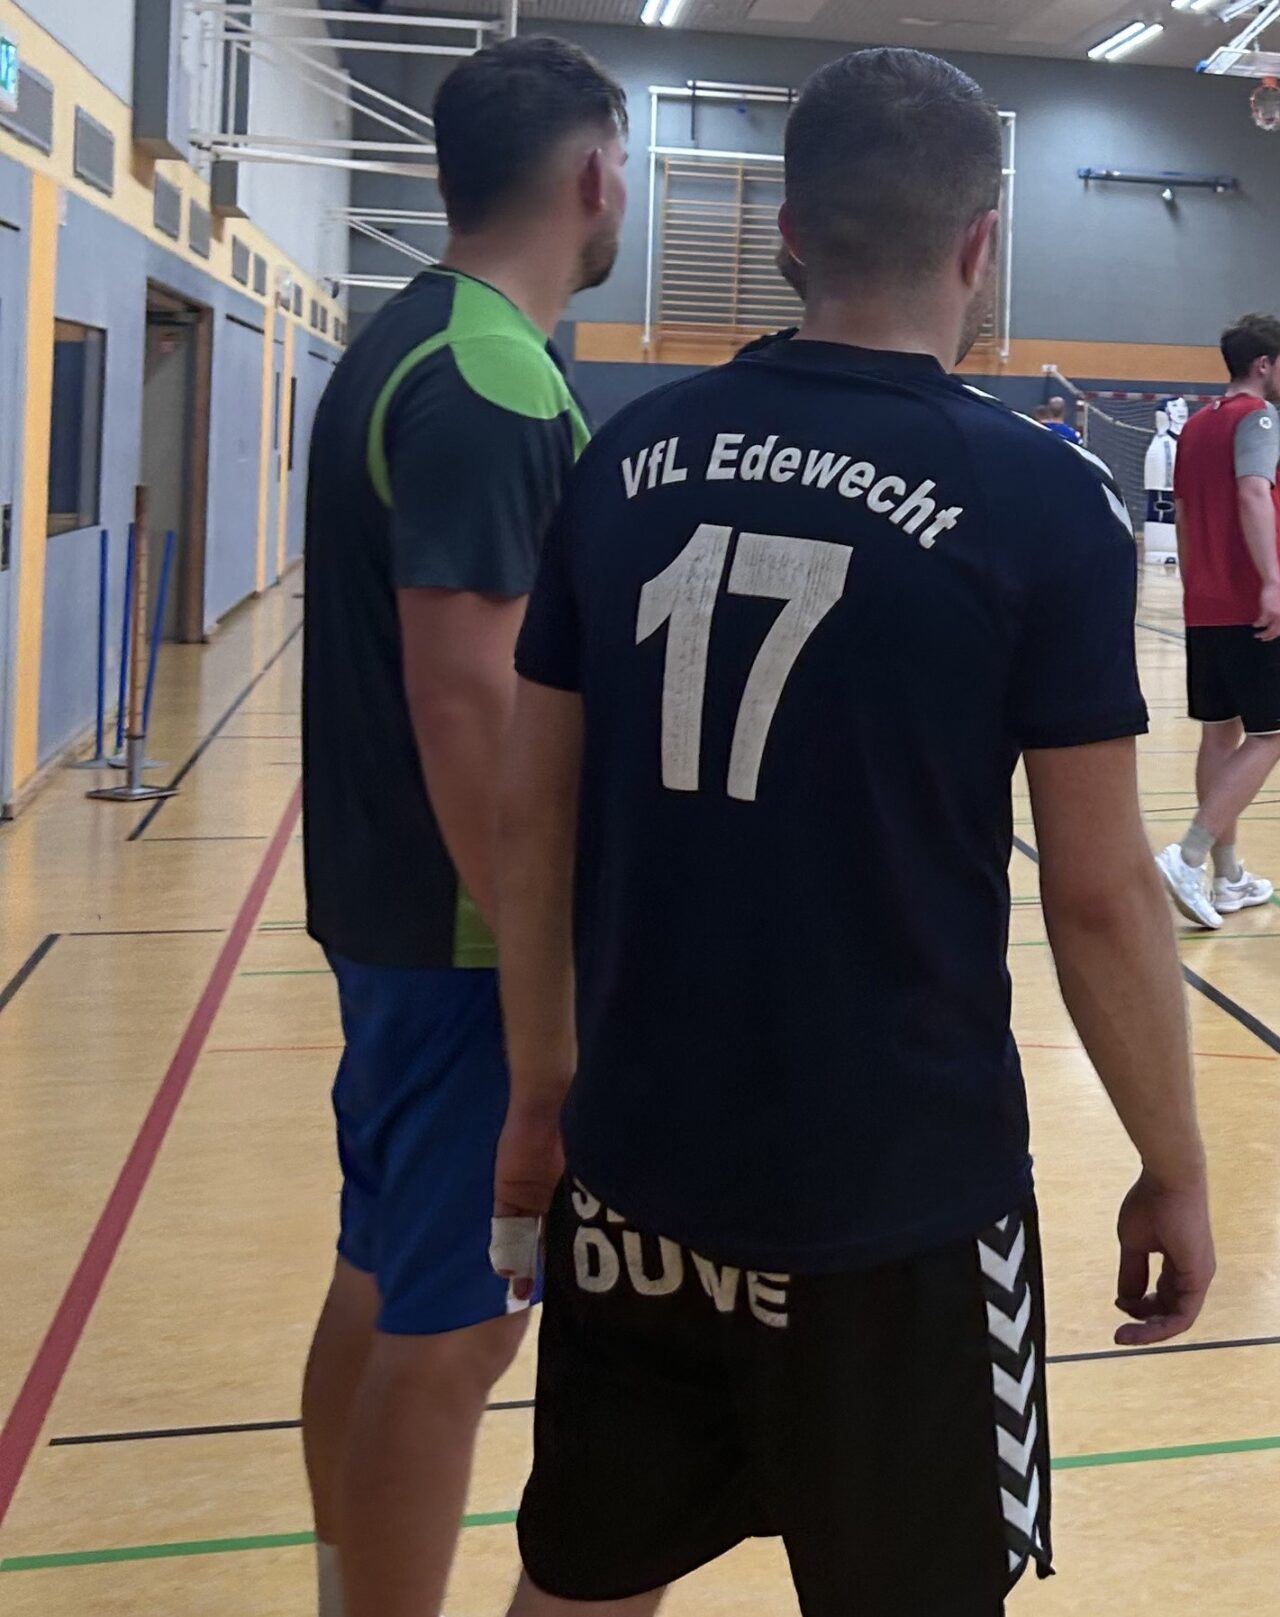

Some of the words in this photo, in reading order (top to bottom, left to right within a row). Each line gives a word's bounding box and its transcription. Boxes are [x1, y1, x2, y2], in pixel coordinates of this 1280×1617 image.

[621, 436, 688, 499] VfL
[705, 433, 964, 549] Edewecht
[635, 523, 854, 802] 17
